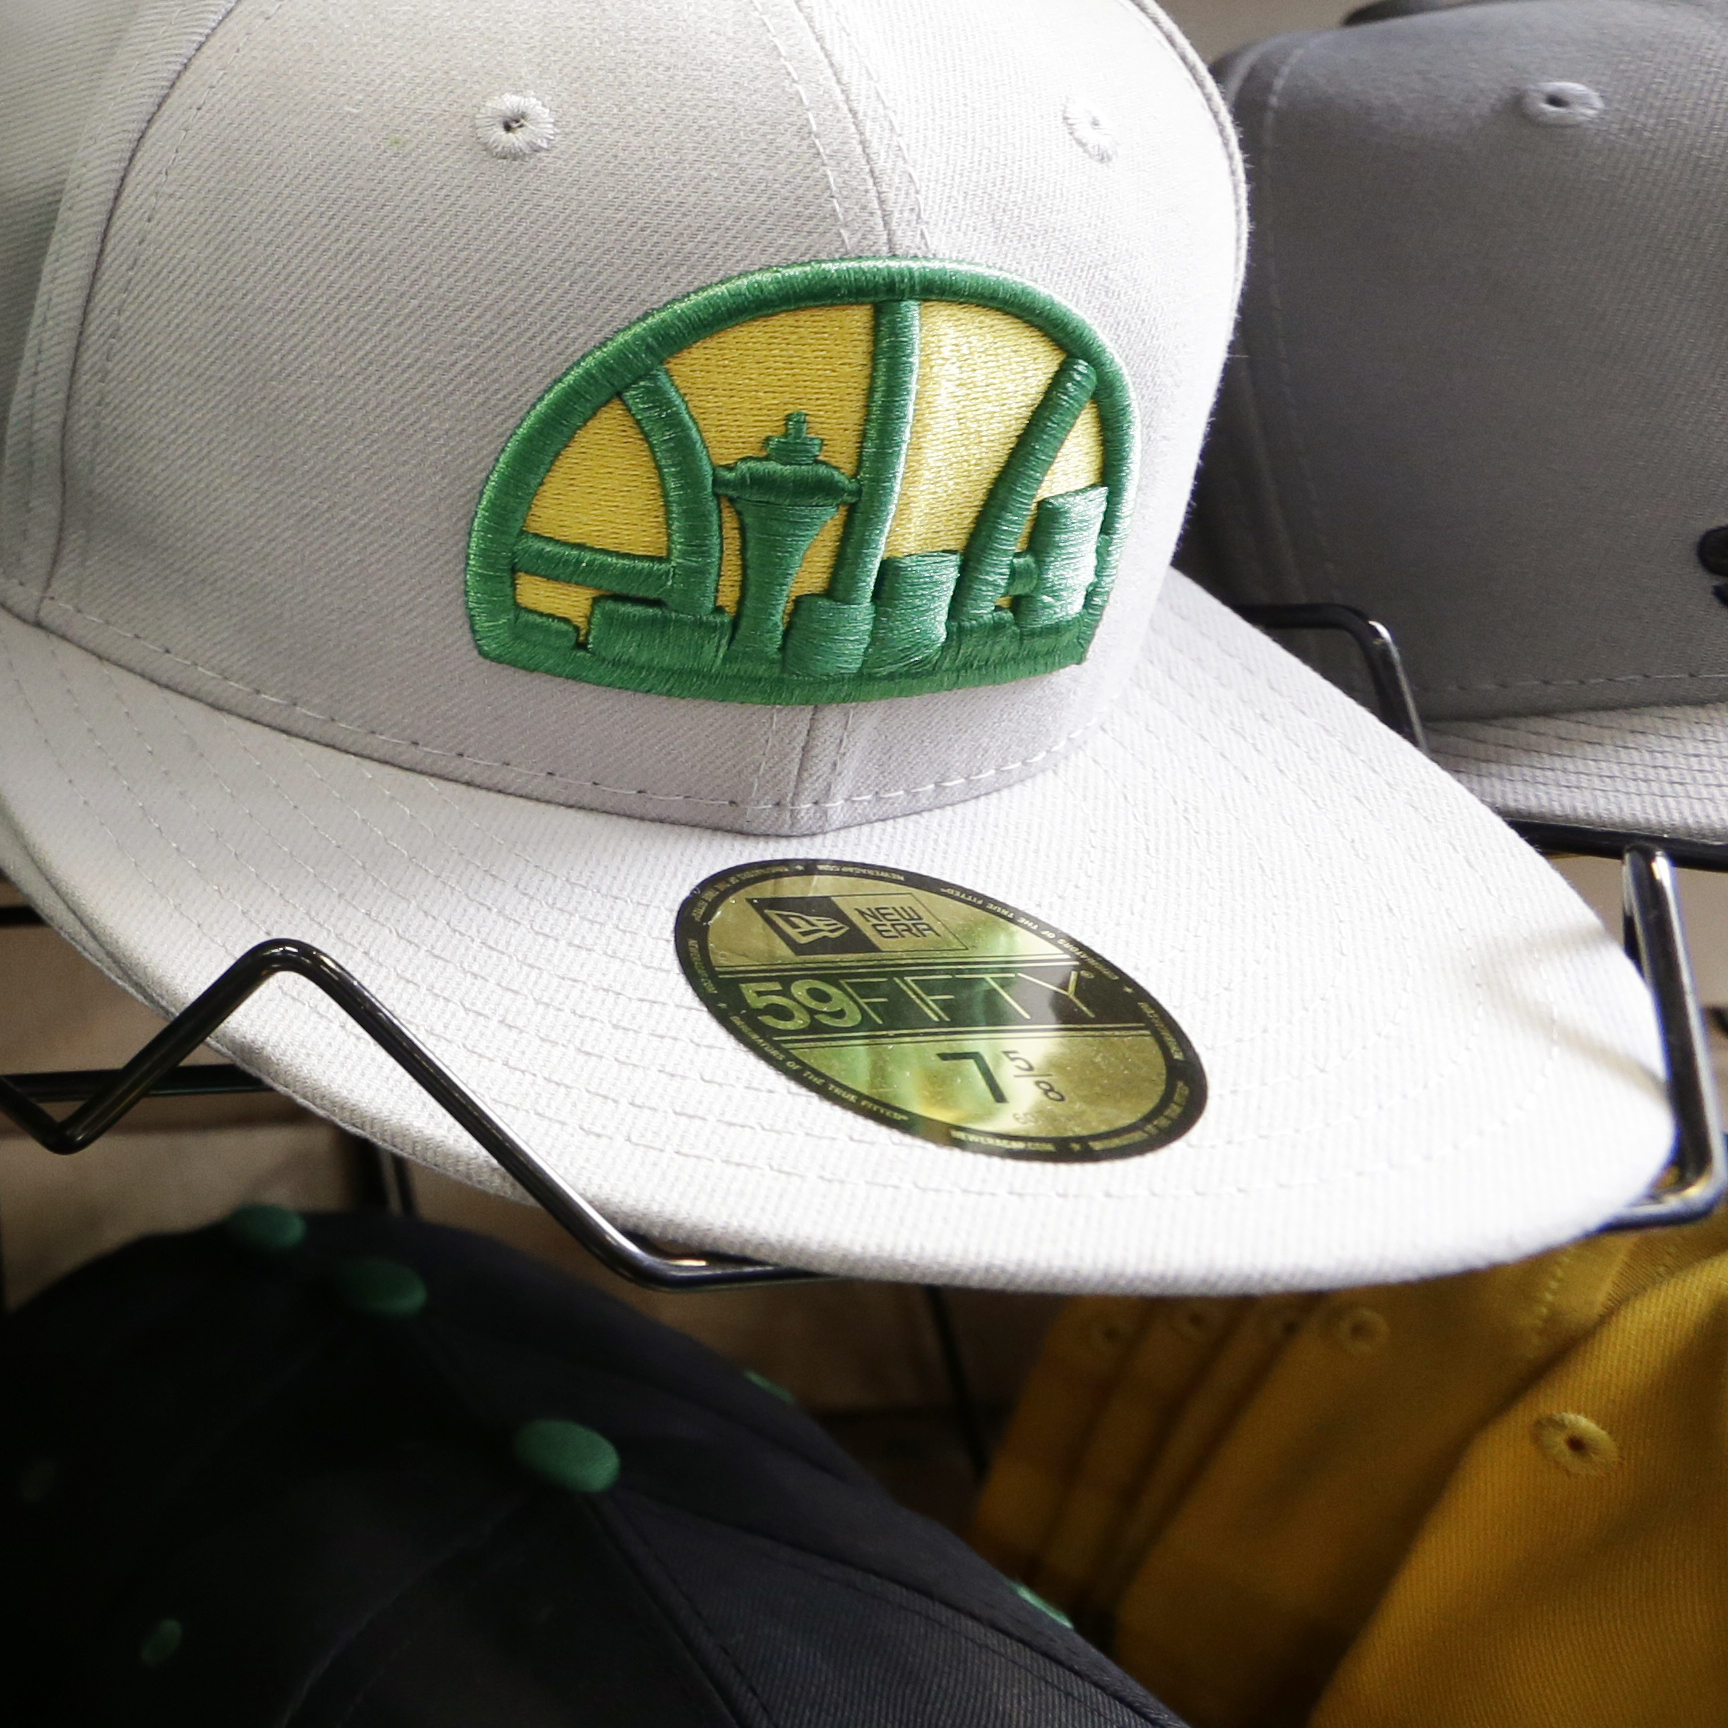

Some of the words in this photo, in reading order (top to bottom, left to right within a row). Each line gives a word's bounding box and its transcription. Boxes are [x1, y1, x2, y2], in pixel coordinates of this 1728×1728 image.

[854, 906, 924, 923] NEW
[985, 902, 1015, 920] TRUE
[872, 922, 942, 940] ERA
[1018, 916, 1039, 931] THE
[739, 970, 1096, 1032] 59FIFTY
[936, 1050, 1009, 1104] 7
